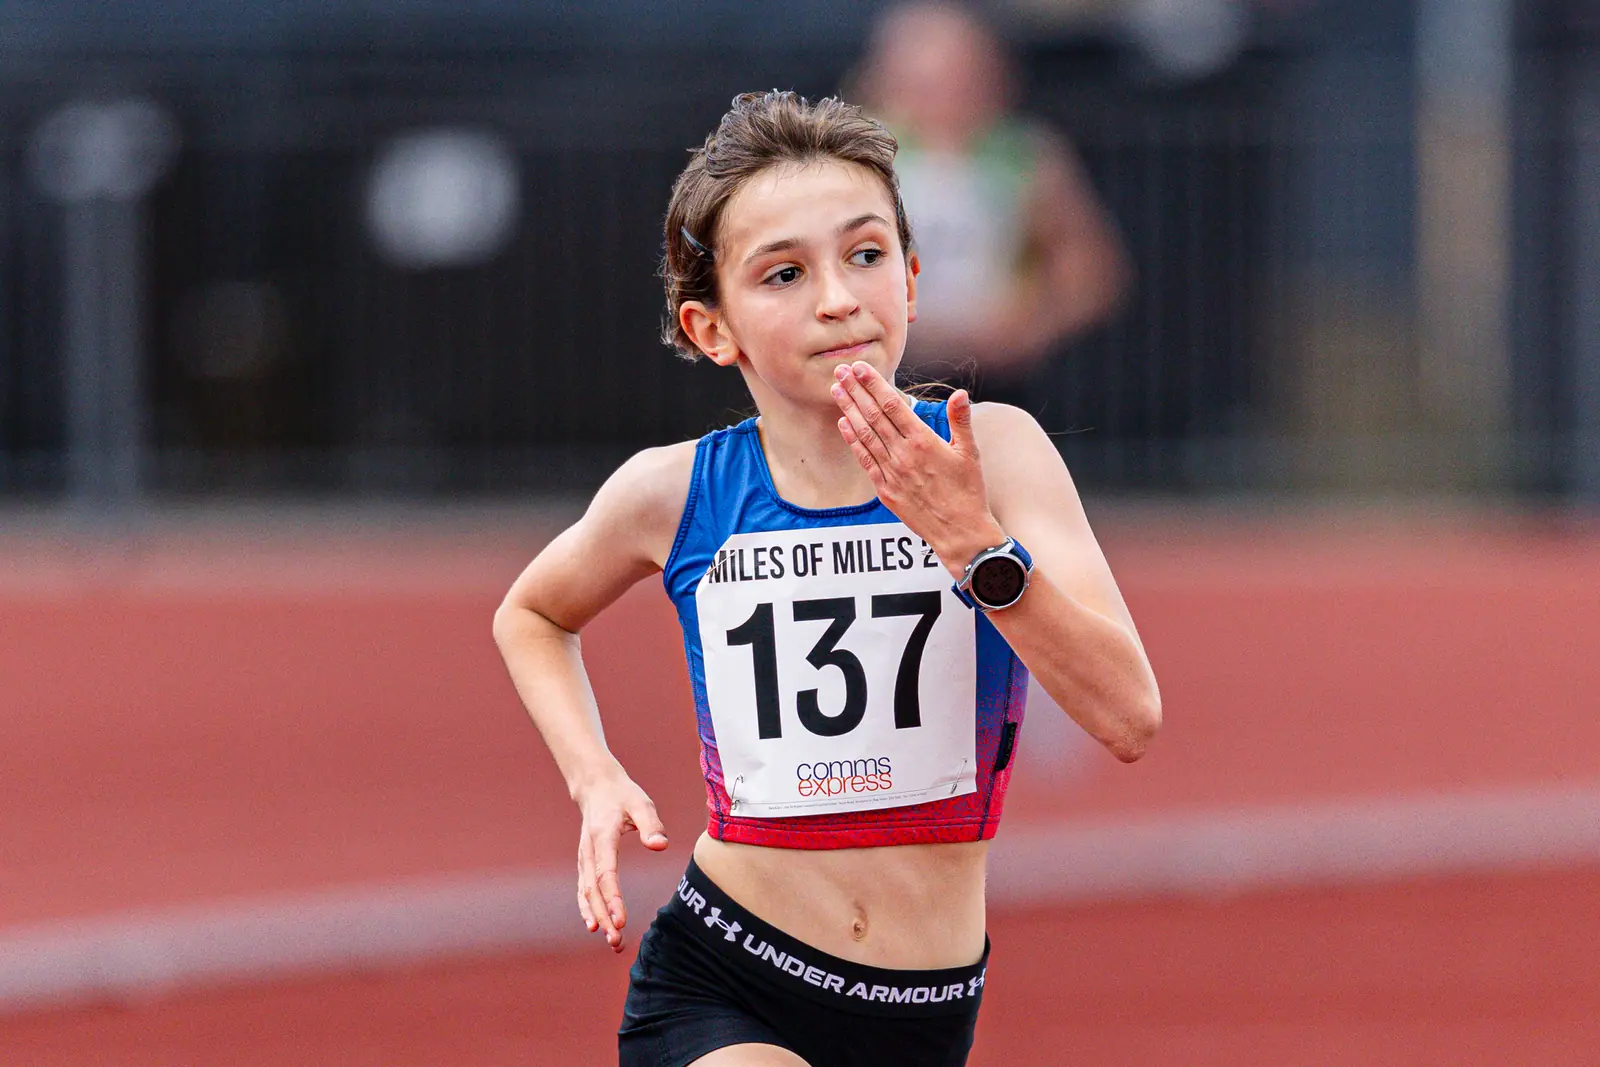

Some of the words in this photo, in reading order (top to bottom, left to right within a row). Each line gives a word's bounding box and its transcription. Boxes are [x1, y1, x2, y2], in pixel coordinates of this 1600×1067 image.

[708, 545, 785, 584] MILES
[792, 543, 824, 578] OF
[832, 536, 914, 575] MILES
[726, 590, 942, 740] 137
[796, 756, 892, 781] comms
[798, 772, 893, 797] express
[743, 933, 845, 994] UNDER
[846, 982, 964, 1004] ARMOUR
